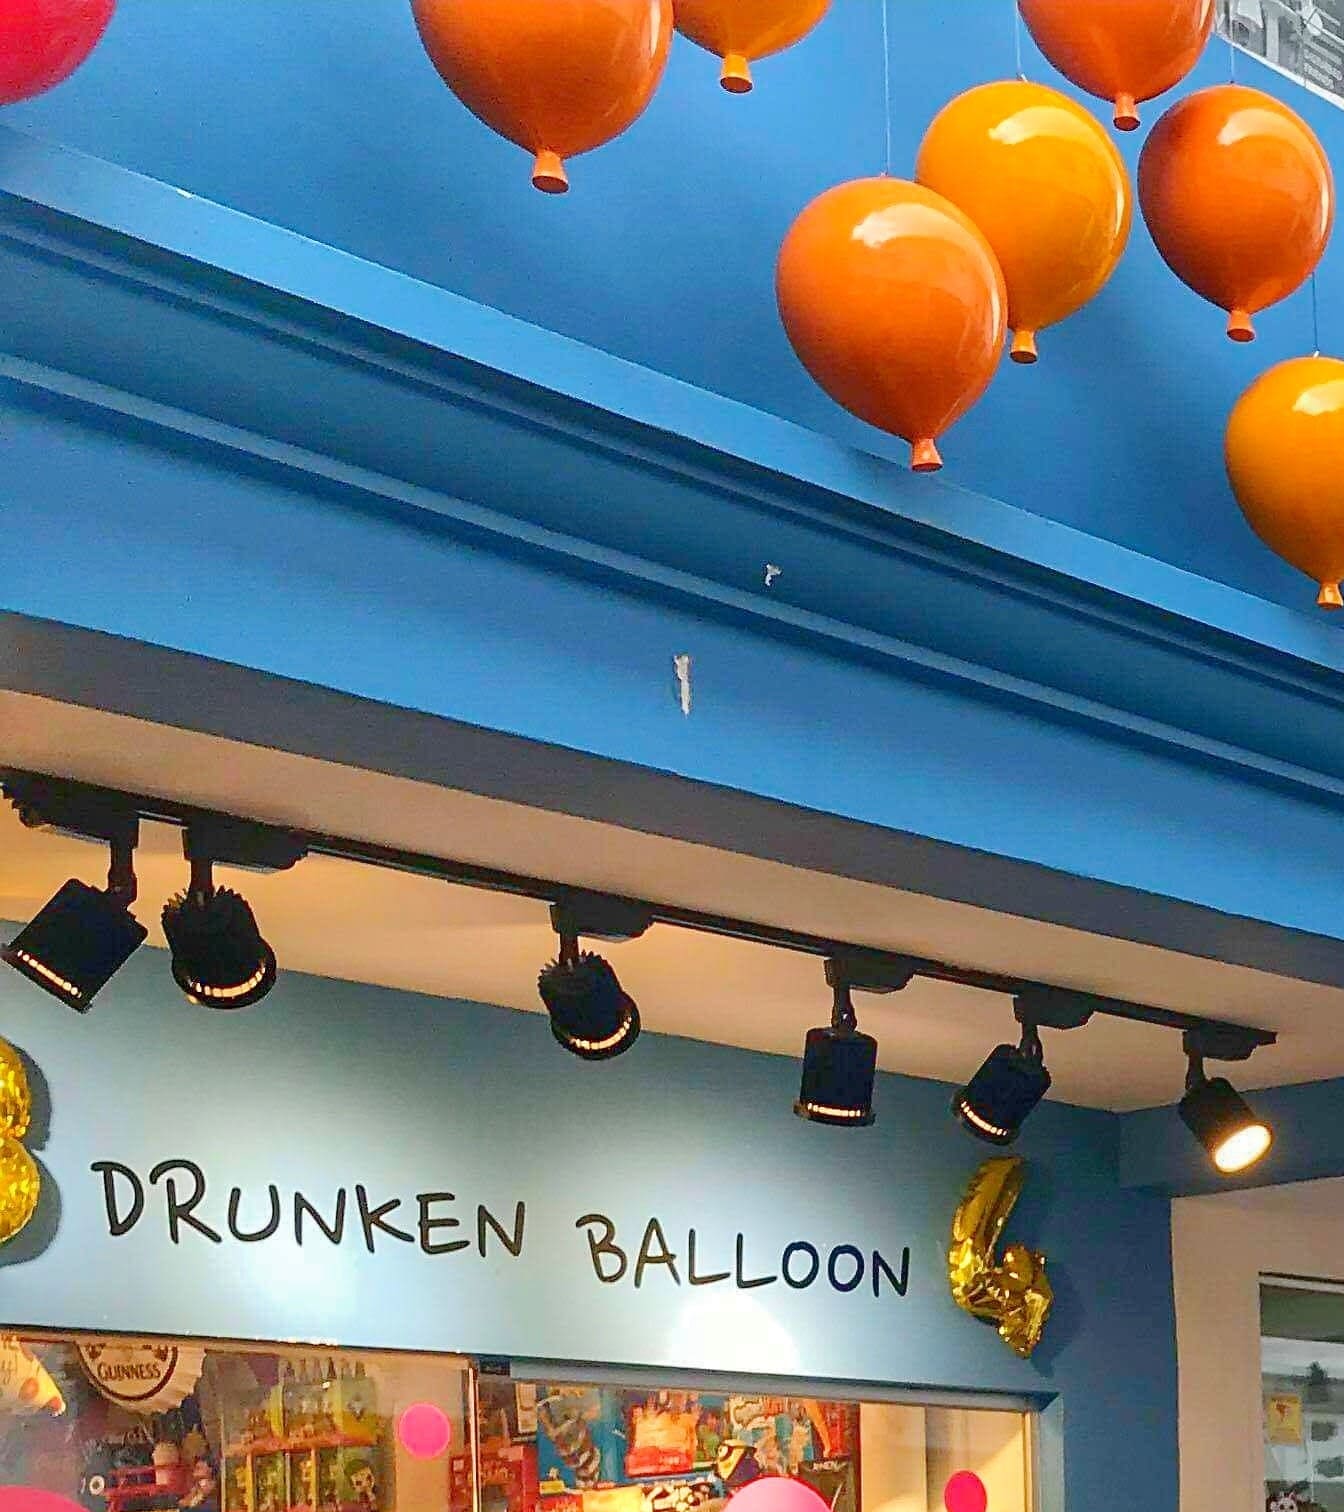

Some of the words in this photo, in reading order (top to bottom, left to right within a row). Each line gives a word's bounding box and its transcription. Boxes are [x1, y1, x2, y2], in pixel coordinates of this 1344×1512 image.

[91, 1158, 527, 1259] DRUNKEN
[576, 1214, 911, 1299] BALLOON
[97, 1364, 161, 1381] GUINNESS
